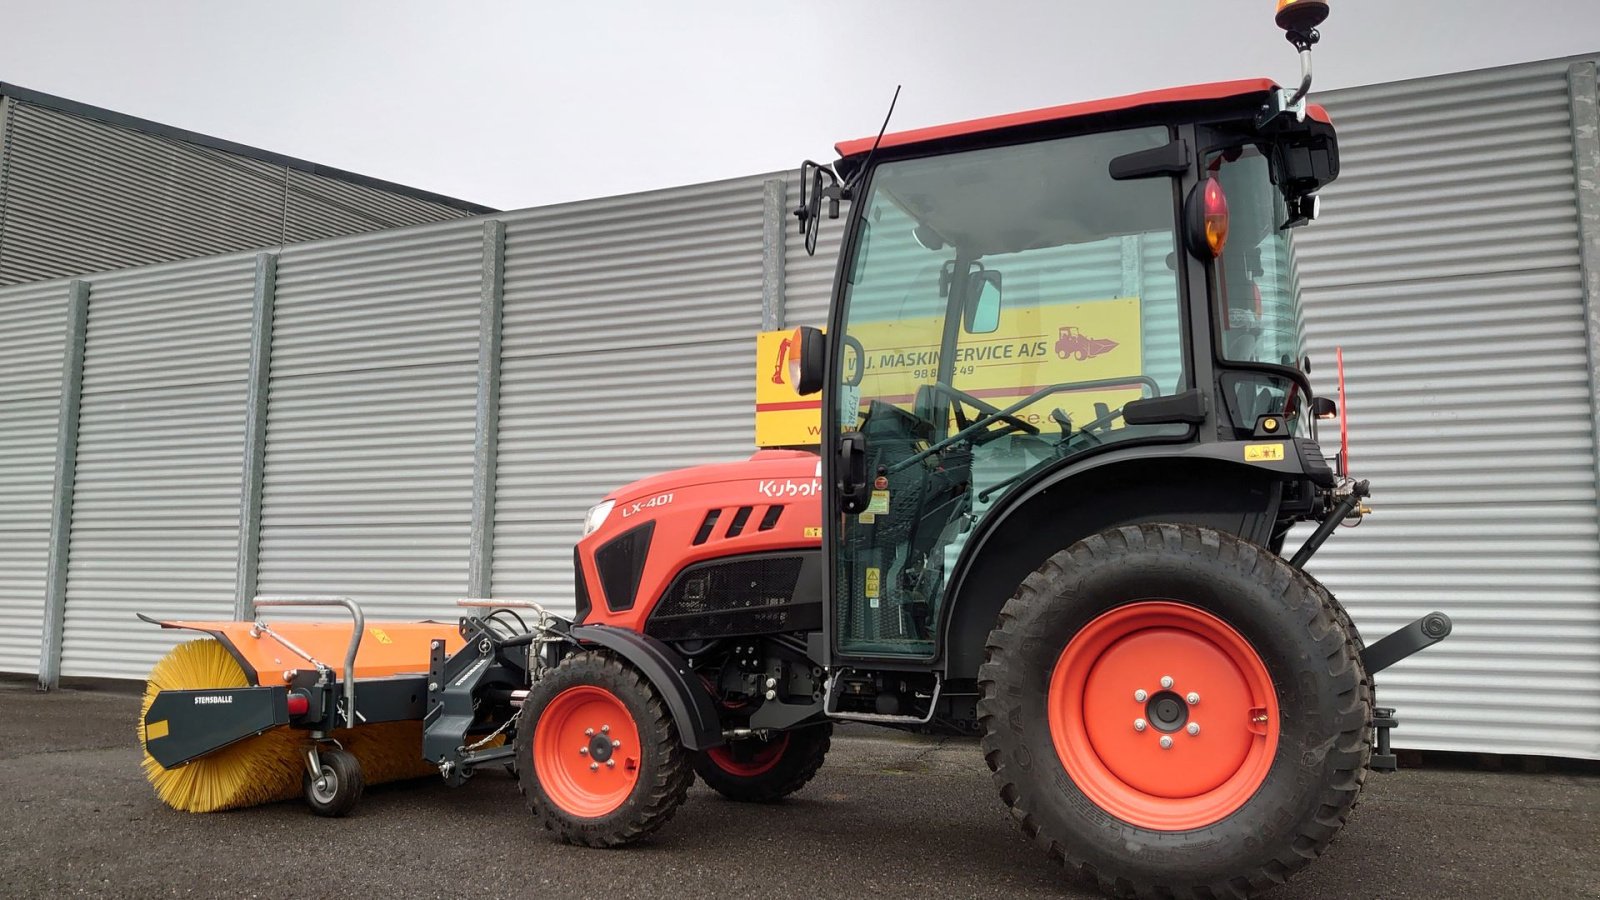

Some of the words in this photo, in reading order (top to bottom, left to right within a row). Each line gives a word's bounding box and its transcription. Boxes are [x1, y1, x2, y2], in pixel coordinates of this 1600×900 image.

[880, 344, 1013, 369] MASKINERVICE
[1017, 341, 1048, 358] A/S
[913, 368, 928, 379] 98
[959, 365, 974, 375] 49
[622, 493, 674, 518] LX-401
[194, 695, 233, 705] STENSBALLE
